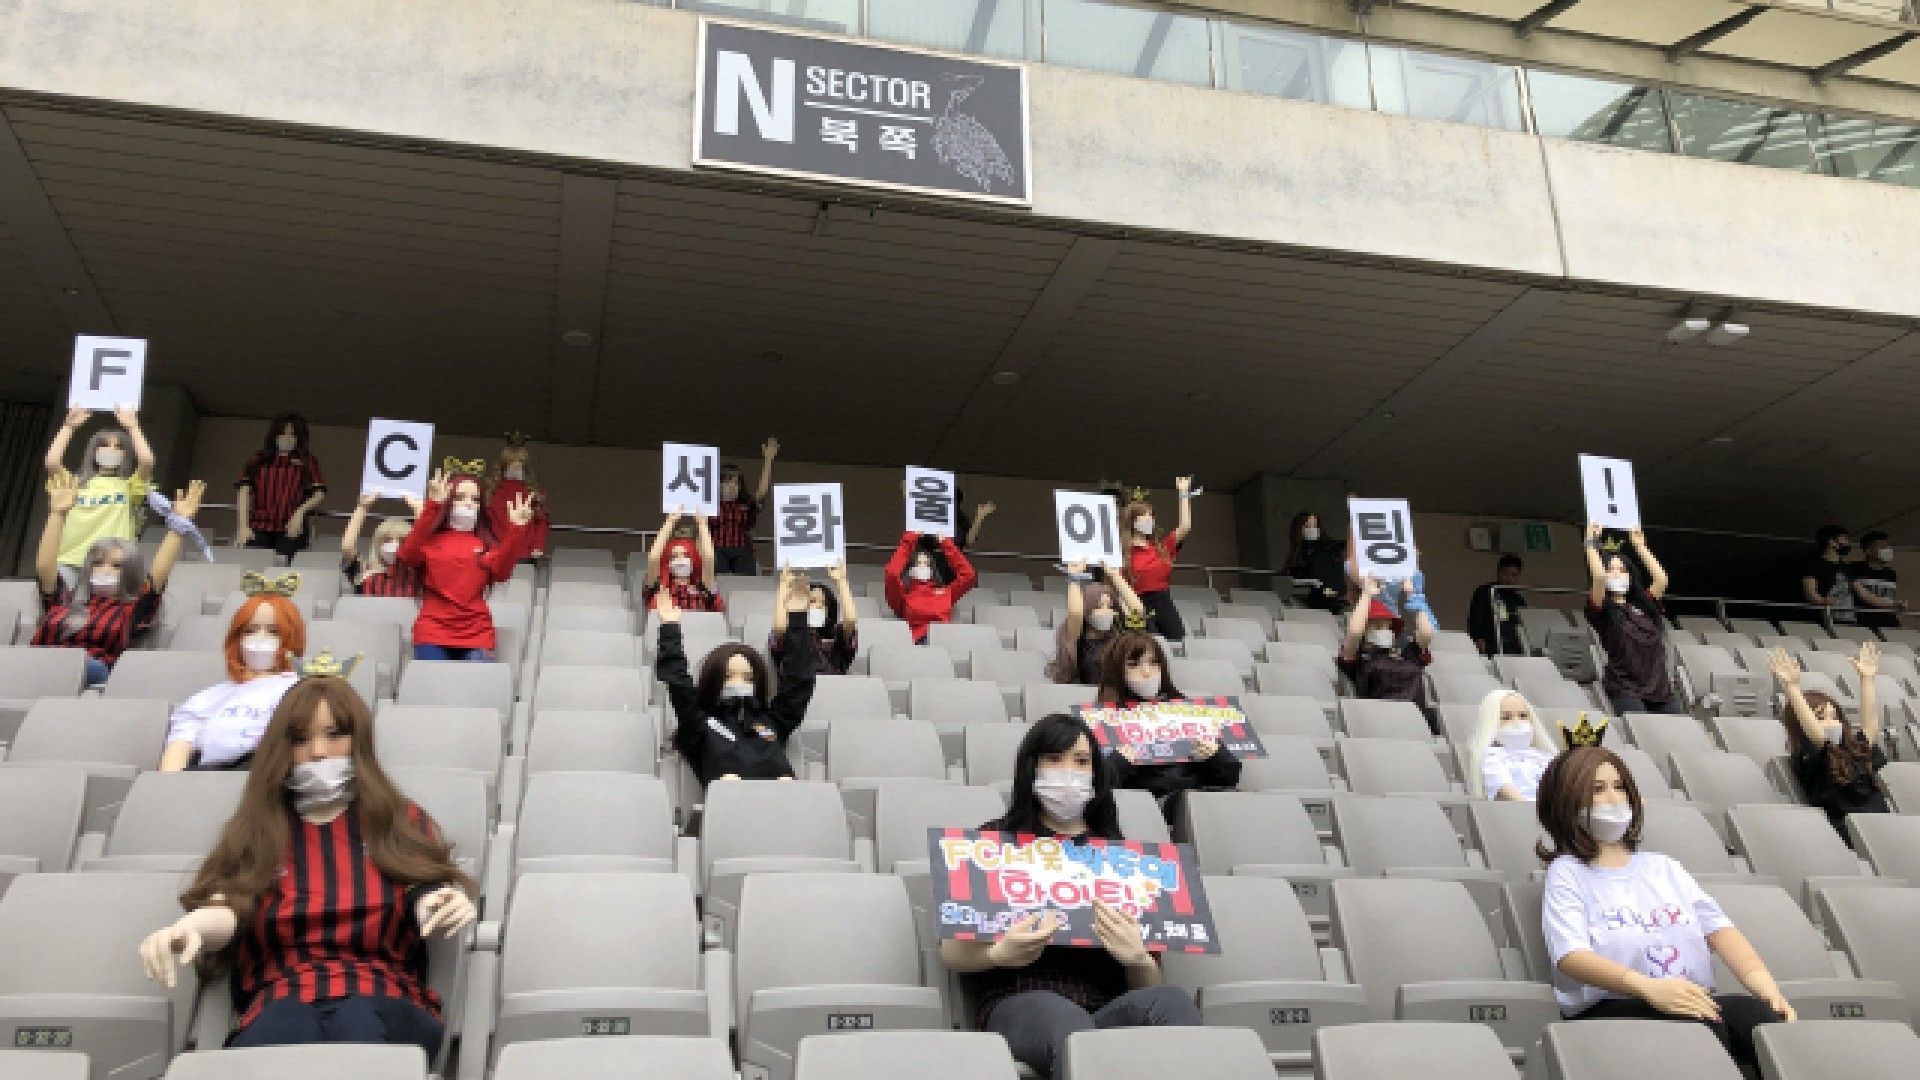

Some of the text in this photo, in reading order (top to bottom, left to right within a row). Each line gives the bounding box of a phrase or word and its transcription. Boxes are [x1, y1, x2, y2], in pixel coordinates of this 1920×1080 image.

[713, 48, 796, 144] N
[805, 65, 931, 109] SECTOR
[89, 347, 132, 391] F
[374, 431, 418, 480] C
[667, 455, 712, 502] 서
[909, 475, 951, 525] 울
[1604, 467, 1619, 514] !
[779, 494, 841, 551] 화
[1063, 503, 1115, 554] 이
[1357, 508, 1408, 565] 팅
